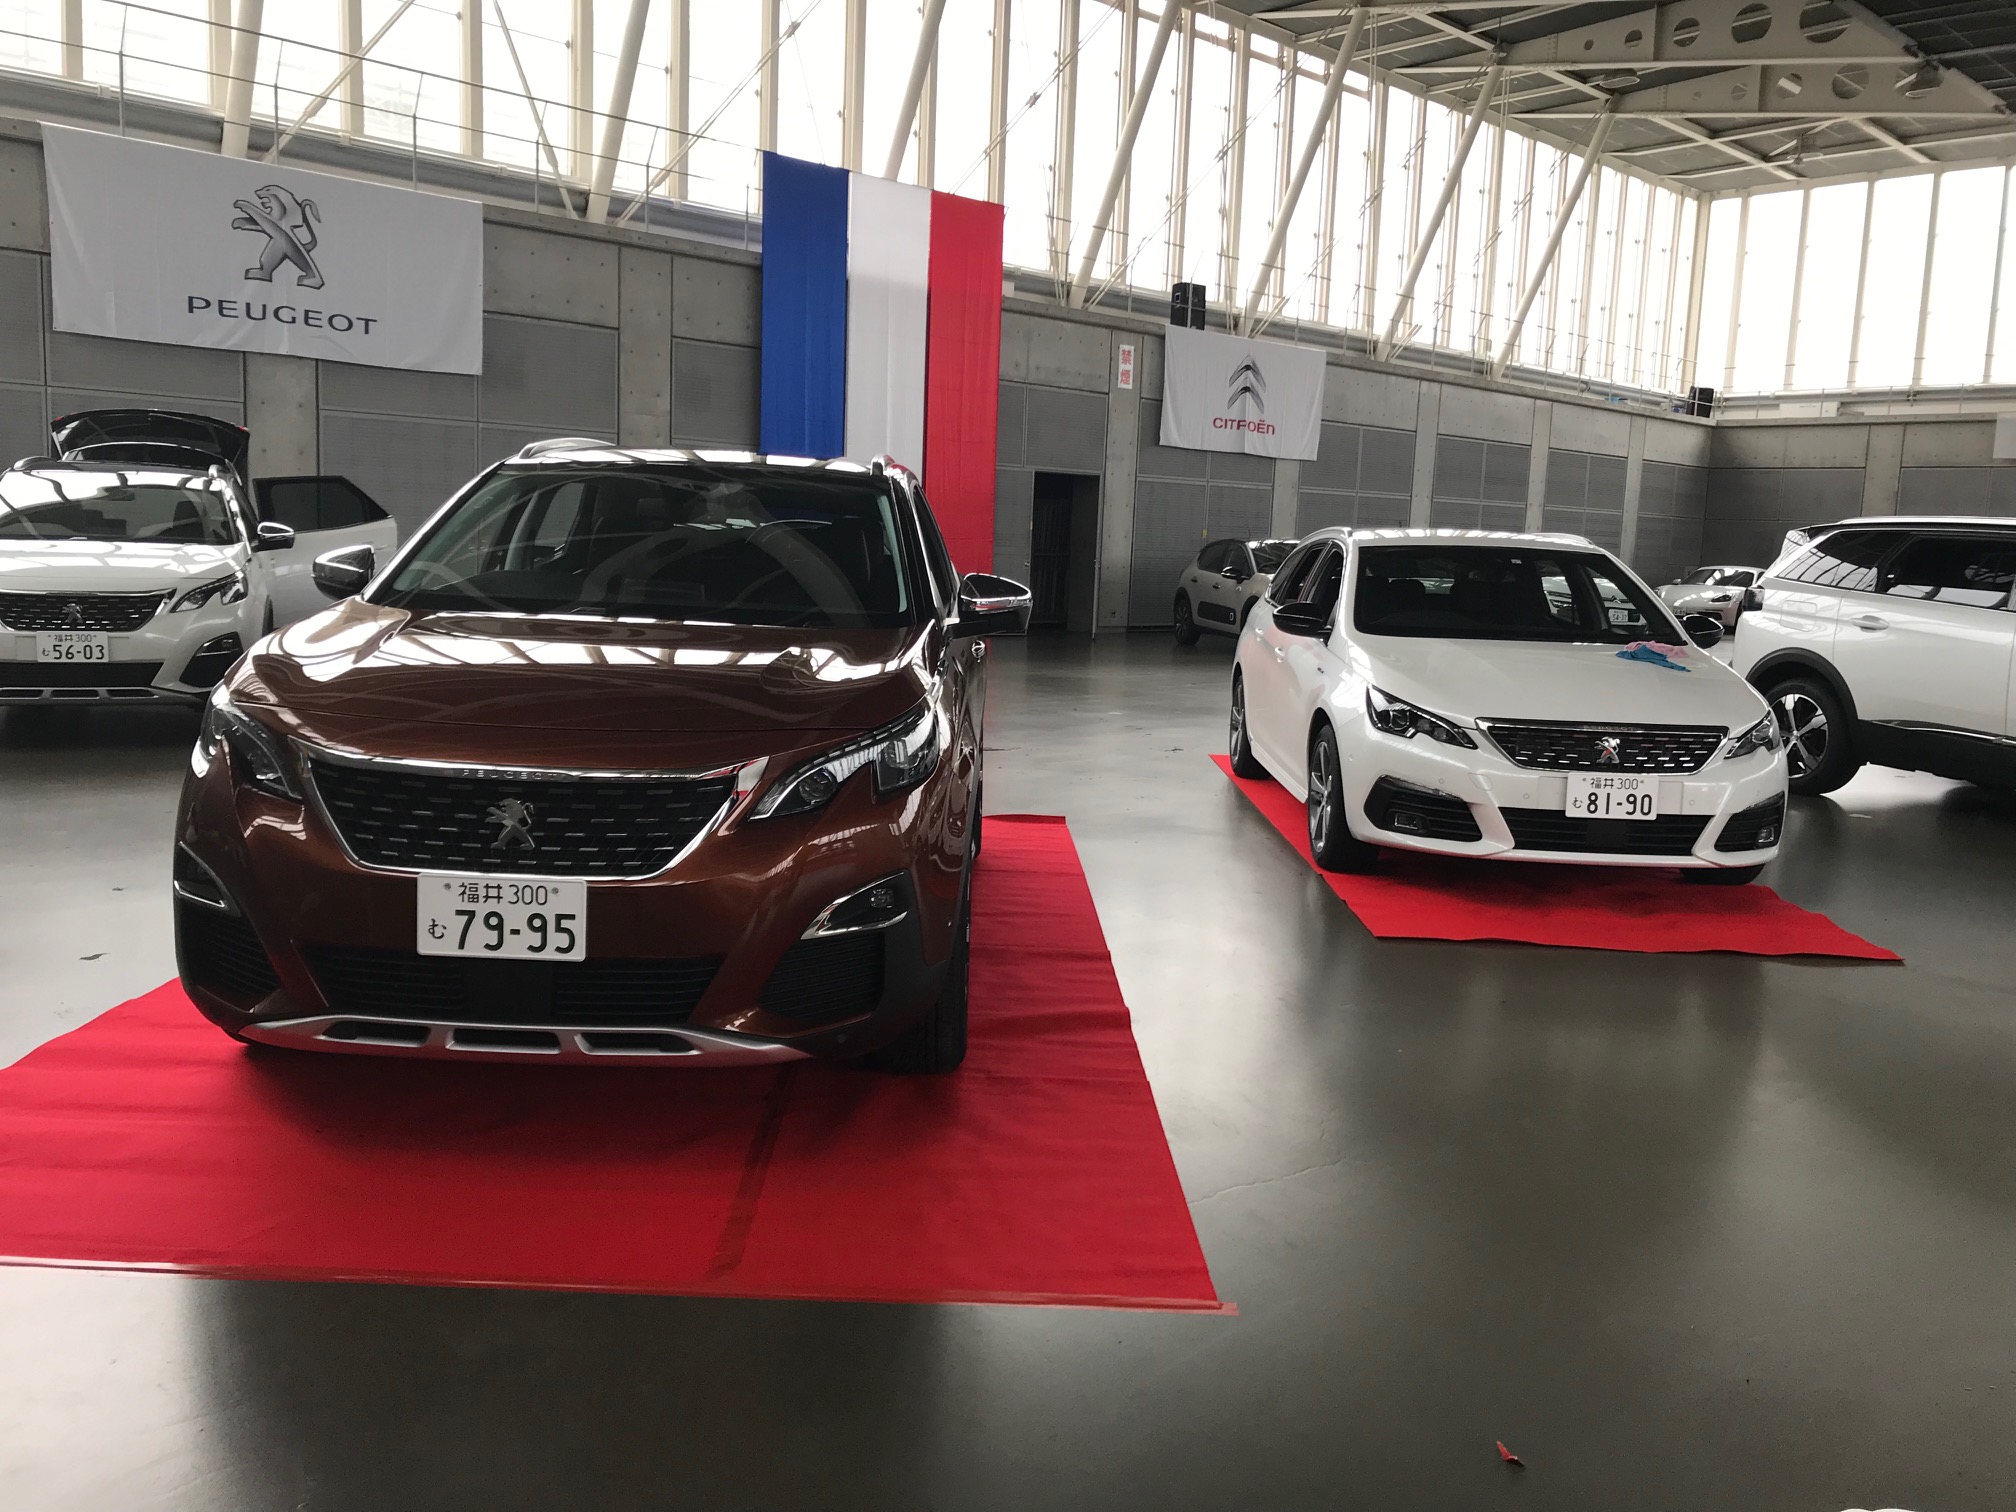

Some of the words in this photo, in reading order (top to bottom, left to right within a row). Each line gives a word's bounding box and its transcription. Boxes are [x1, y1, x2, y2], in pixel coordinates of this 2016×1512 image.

[187, 295, 378, 335] PEUGEOT
[1119, 348, 1132, 386] 禁煙
[52, 644, 105, 660] 56-03
[1587, 792, 1653, 816] 81-90
[427, 918, 447, 939] む
[454, 909, 576, 954] 79-95
